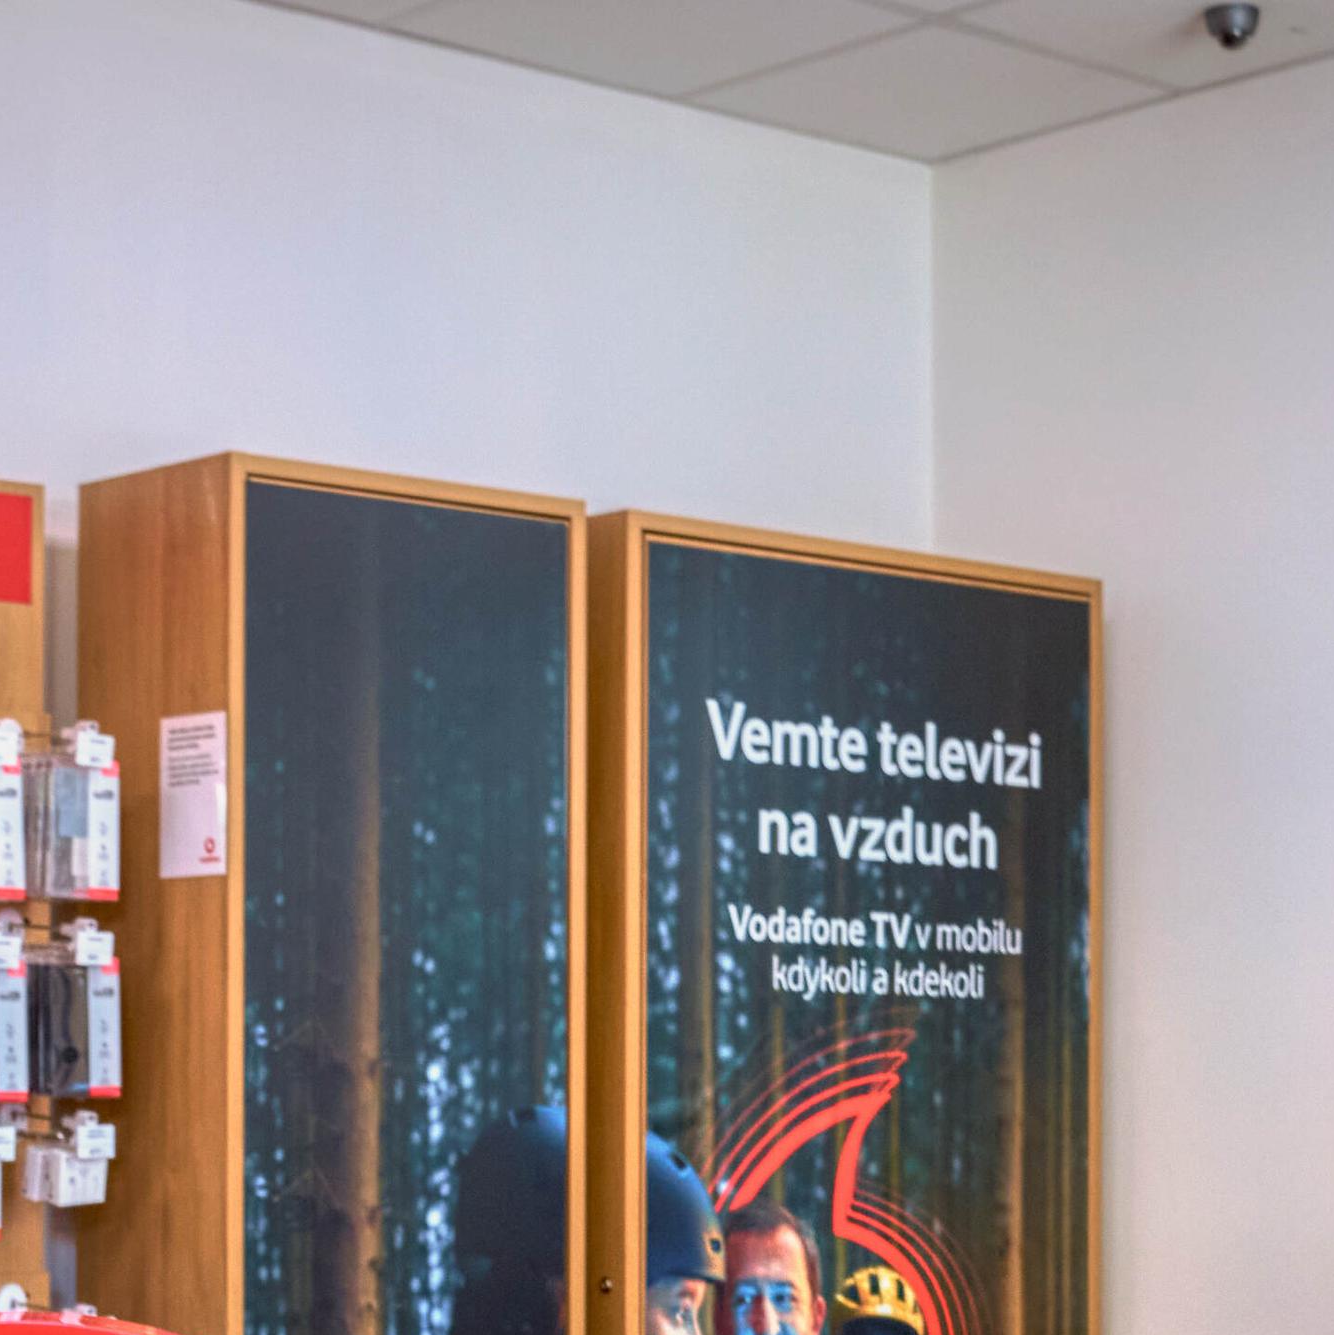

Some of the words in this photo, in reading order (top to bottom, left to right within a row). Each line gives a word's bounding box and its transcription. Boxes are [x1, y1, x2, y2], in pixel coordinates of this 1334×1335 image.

[705, 698, 868, 773] Vemte
[876, 721, 1043, 789] televizi
[758, 808, 817, 857] na
[828, 805, 999, 870] vzduch
[728, 903, 865, 946] Vodafone
[870, 911, 912, 948] TV
[915, 924, 931, 950] v
[936, 917, 1023, 954] mobilu
[772, 954, 866, 1000] kdykoli
[872, 972, 888, 994] a
[894, 961, 985, 999] kdekoli
